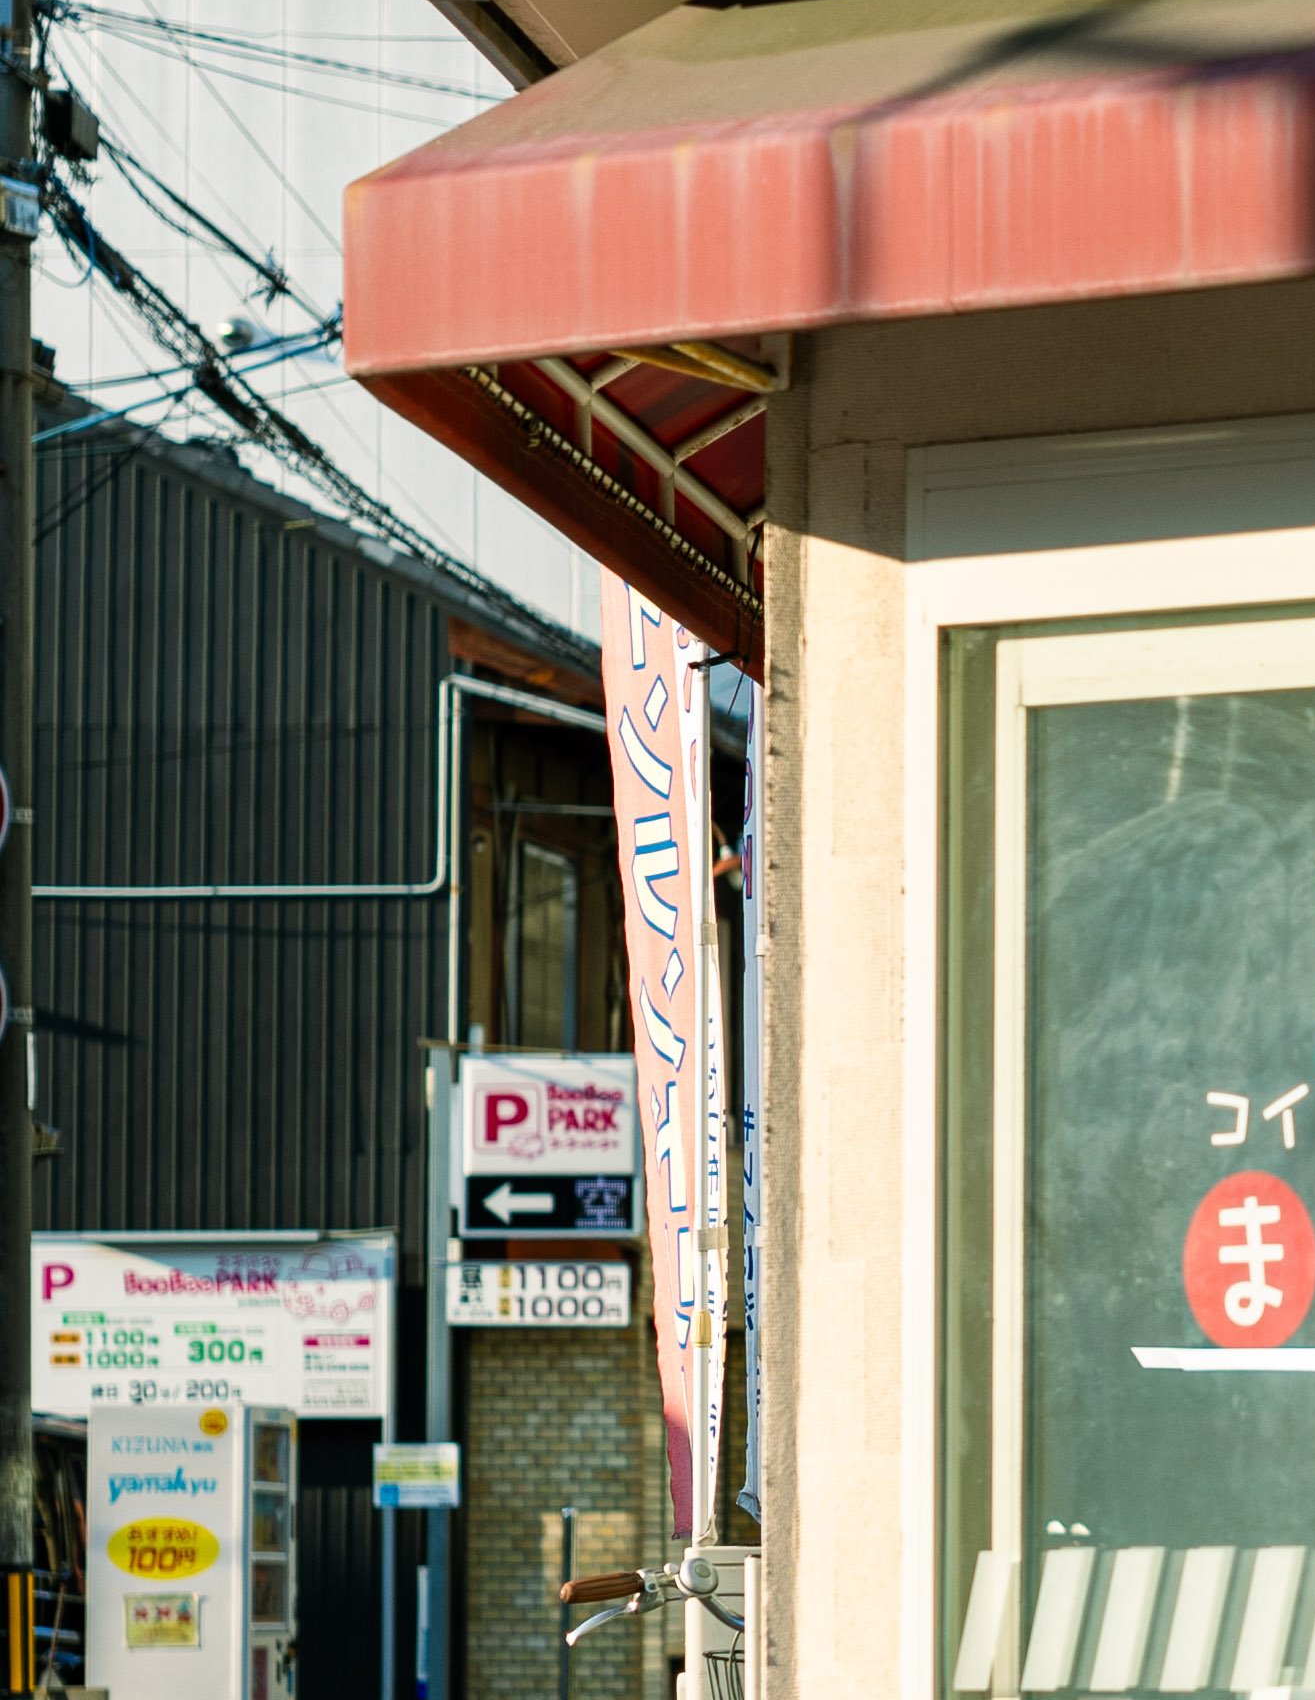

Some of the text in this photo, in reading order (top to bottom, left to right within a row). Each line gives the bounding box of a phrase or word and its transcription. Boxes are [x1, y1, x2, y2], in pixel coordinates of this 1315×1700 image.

[485, 1094, 528, 1142] P
[548, 1108, 618, 1133] PARK
[42, 1263, 75, 1302] P
[111, 1436, 189, 1453] KIZUNA
[109, 1466, 217, 1505] yamakyu
